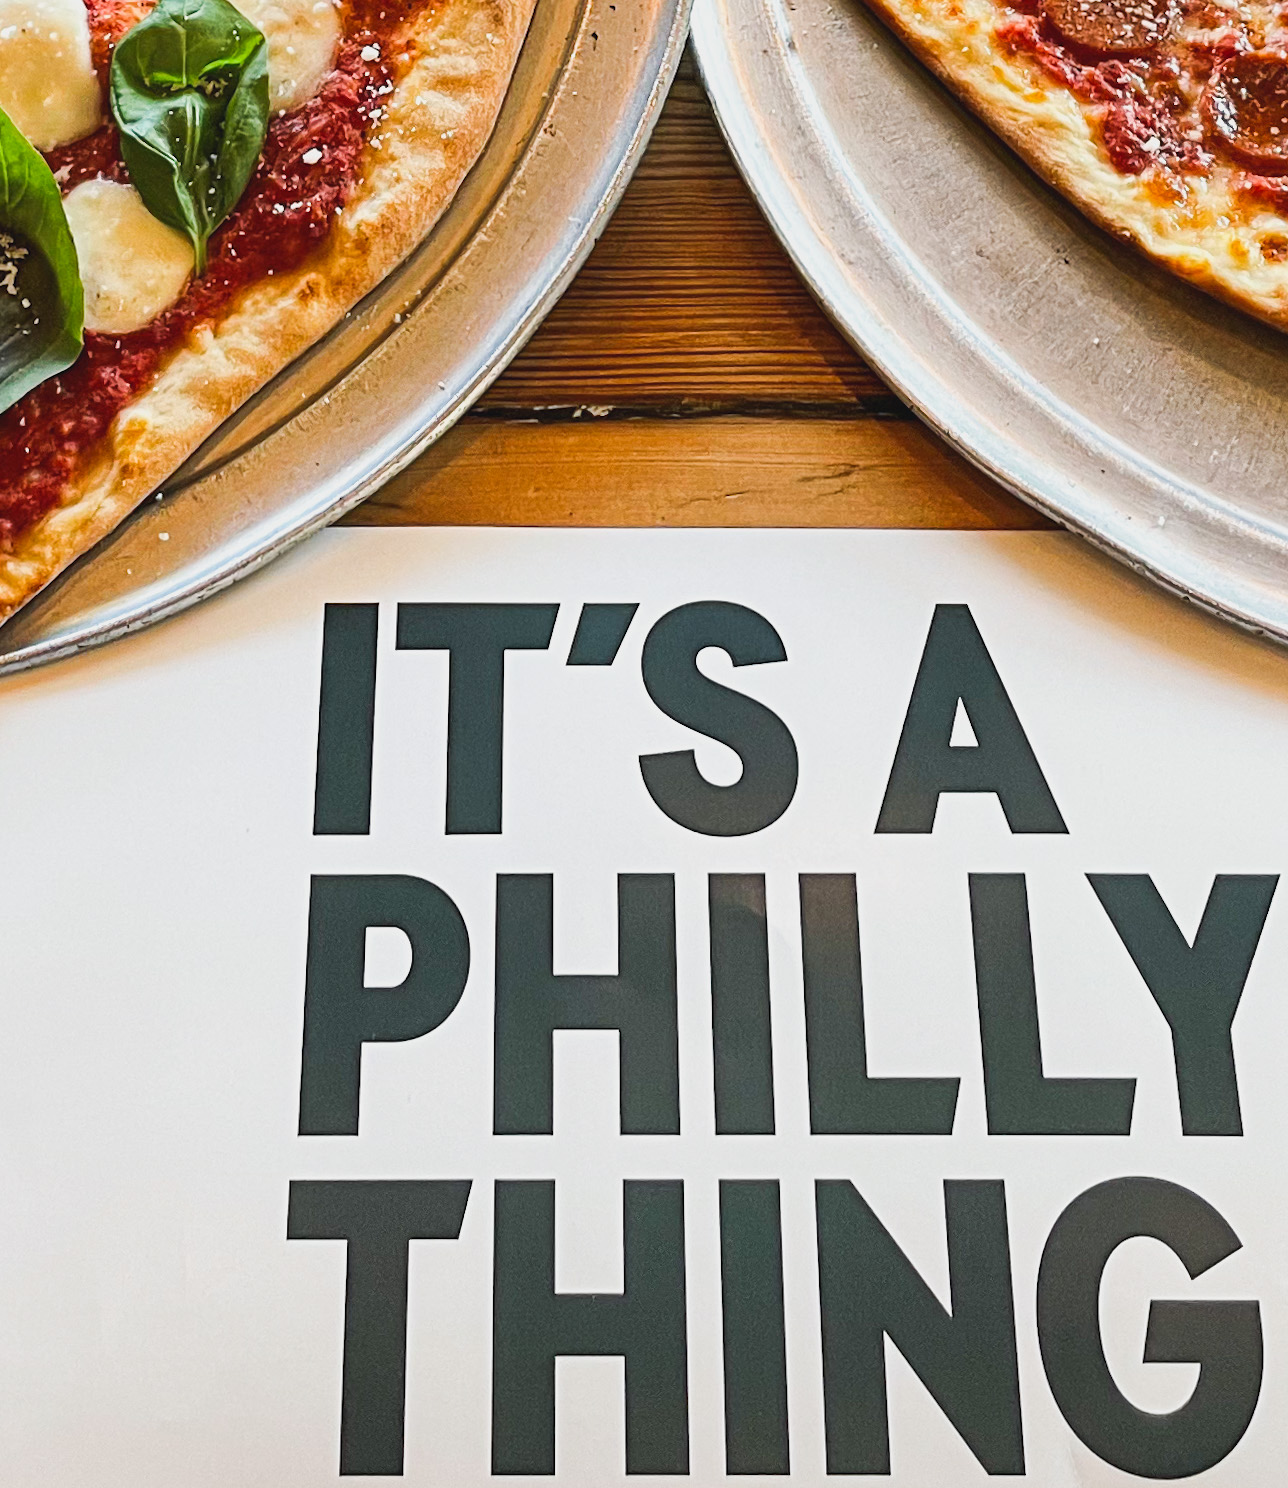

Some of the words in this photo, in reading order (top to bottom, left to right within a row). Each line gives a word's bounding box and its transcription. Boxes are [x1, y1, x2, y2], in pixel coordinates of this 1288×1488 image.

[312, 601, 799, 837] IT'S
[874, 603, 1070, 835] A
[298, 873, 1281, 1136] PHILLY
[287, 1177, 1264, 1480] THING
